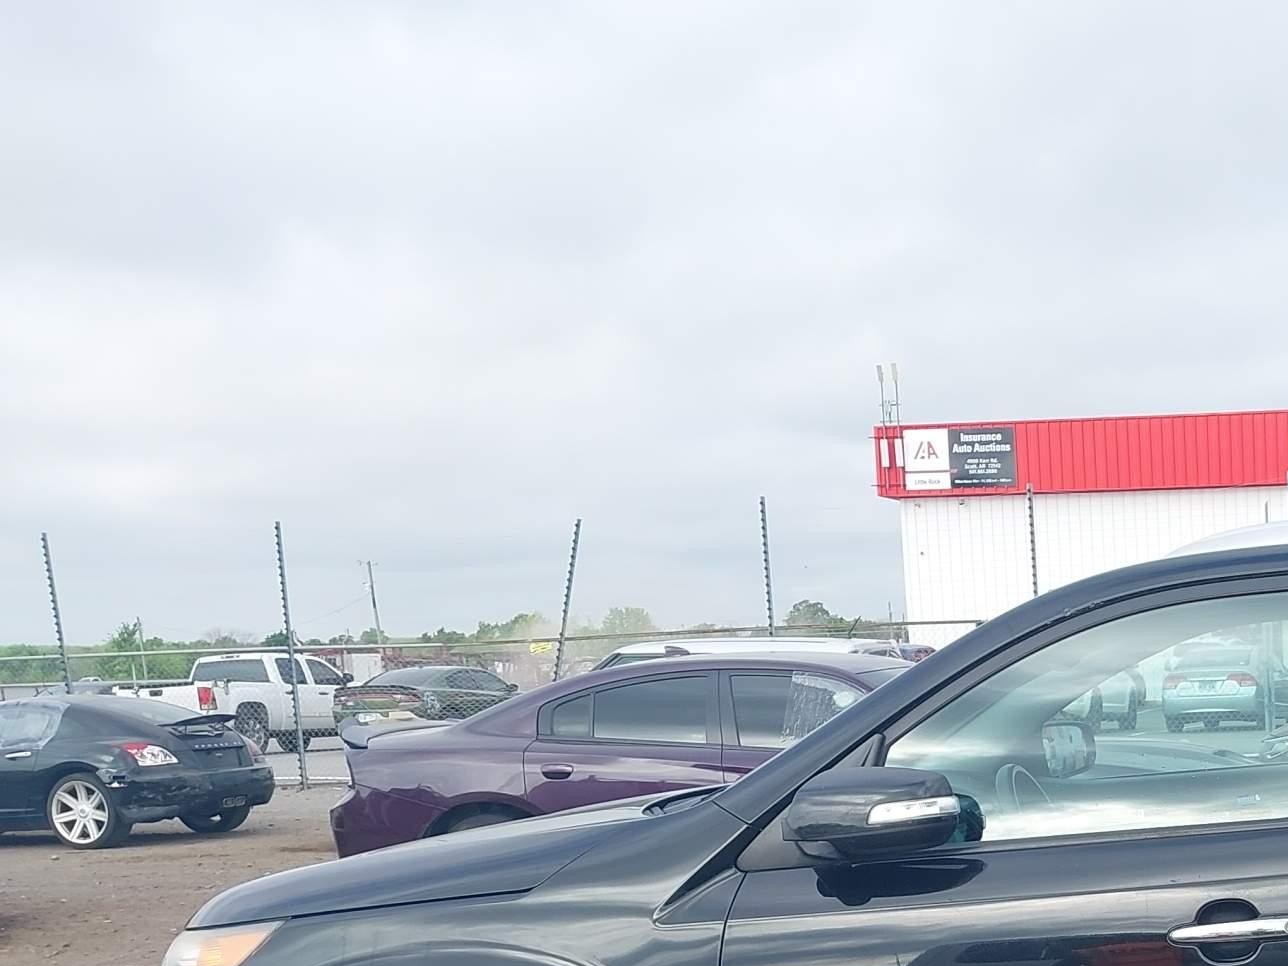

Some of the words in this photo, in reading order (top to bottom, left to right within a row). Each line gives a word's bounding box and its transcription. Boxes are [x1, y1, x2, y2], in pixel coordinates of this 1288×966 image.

[960, 432, 1002, 442] Insurance
[952, 443, 972, 453] Auto
[973, 442, 1011, 453] Auctions
